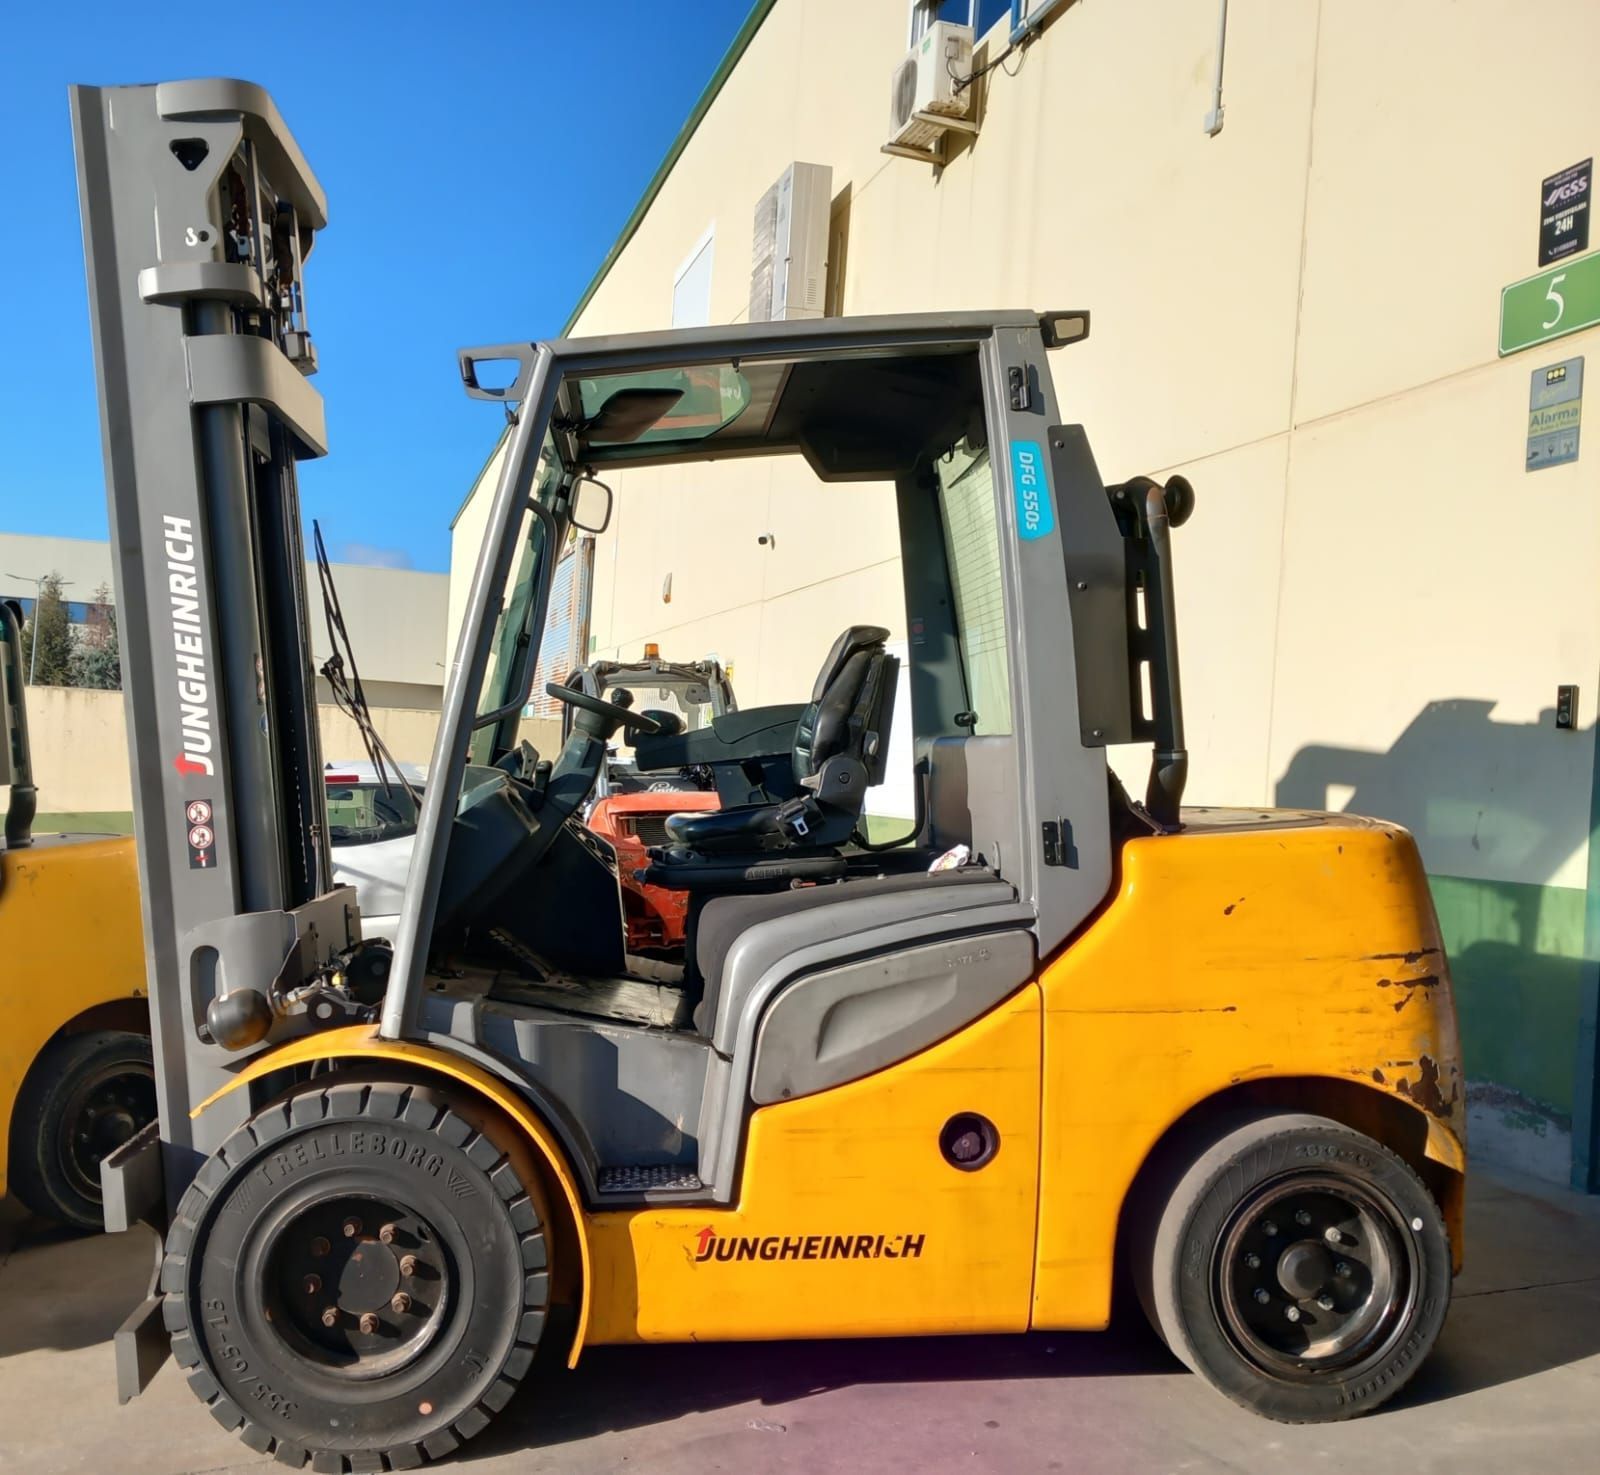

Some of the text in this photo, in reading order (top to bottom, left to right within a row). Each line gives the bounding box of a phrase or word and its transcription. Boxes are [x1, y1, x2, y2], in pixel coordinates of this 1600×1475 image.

[1554, 214, 1574, 236] 24H
[1542, 272, 1566, 329] 5
[1531, 407, 1579, 427] Alarma
[1018, 451, 1040, 531] DFG 550s
[163, 514, 215, 777] JUNGHEINRICH
[256, 1131, 444, 1187] TRELLEBORG
